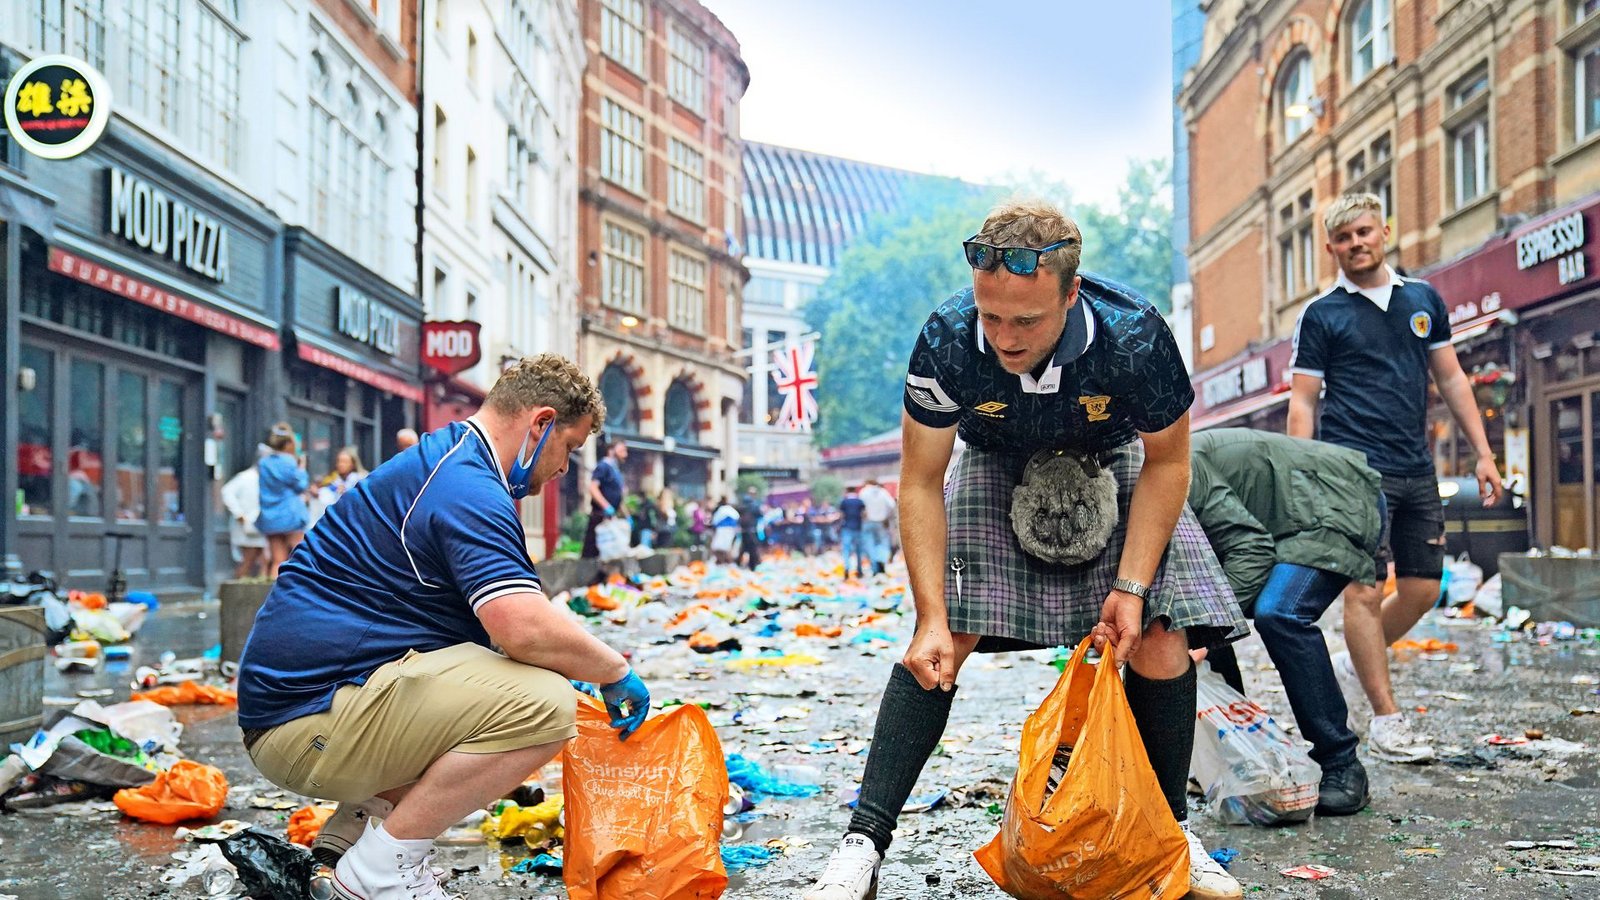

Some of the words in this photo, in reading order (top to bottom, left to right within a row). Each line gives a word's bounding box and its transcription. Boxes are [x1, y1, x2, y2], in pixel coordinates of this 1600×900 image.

[110, 167, 169, 255] MOD
[172, 200, 230, 284] PIZZA
[1516, 210, 1585, 271] ESPRESSO
[61, 255, 188, 313] SUPERFAST
[1558, 251, 1586, 286] BAR
[338, 285, 368, 343] MOD
[369, 298, 400, 357] PIZZA
[426, 330, 473, 358] MOD
